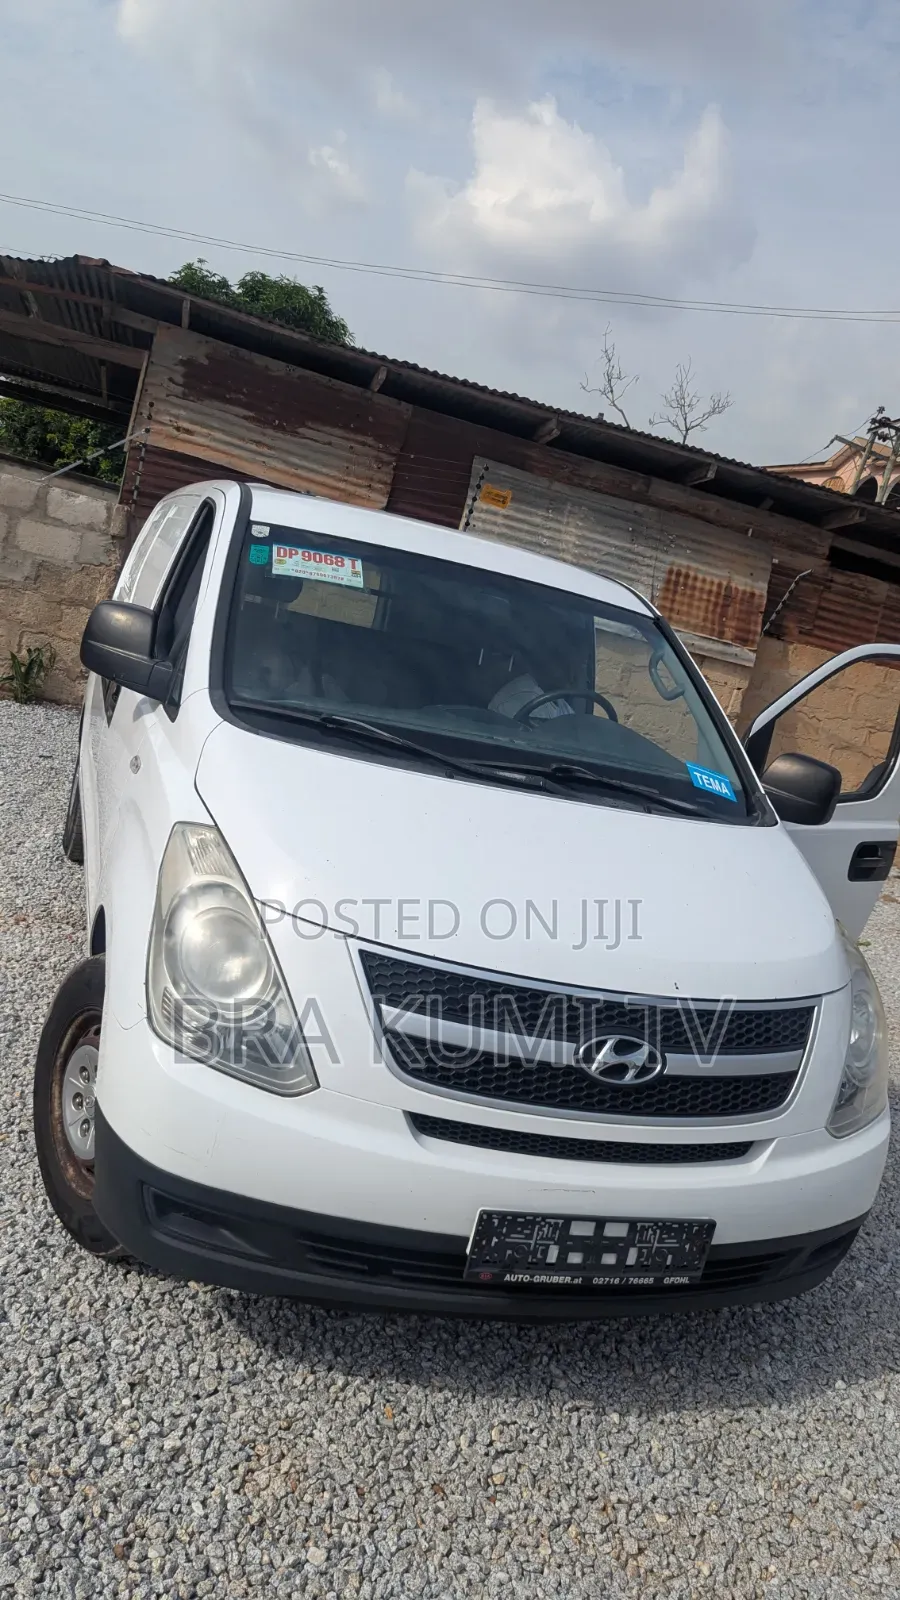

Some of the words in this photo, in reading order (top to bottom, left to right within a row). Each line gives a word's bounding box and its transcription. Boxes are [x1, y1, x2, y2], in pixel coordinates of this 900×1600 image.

[276, 546, 299, 559] DP
[301, 550, 346, 568] 9068
[347, 557, 358, 571] T
[693, 771, 731, 797] TEMA
[503, 1273, 583, 1285] AUTO-GRUBER.at
[592, 1277, 620, 1285] 02716
[628, 1277, 655, 1285] 76665
